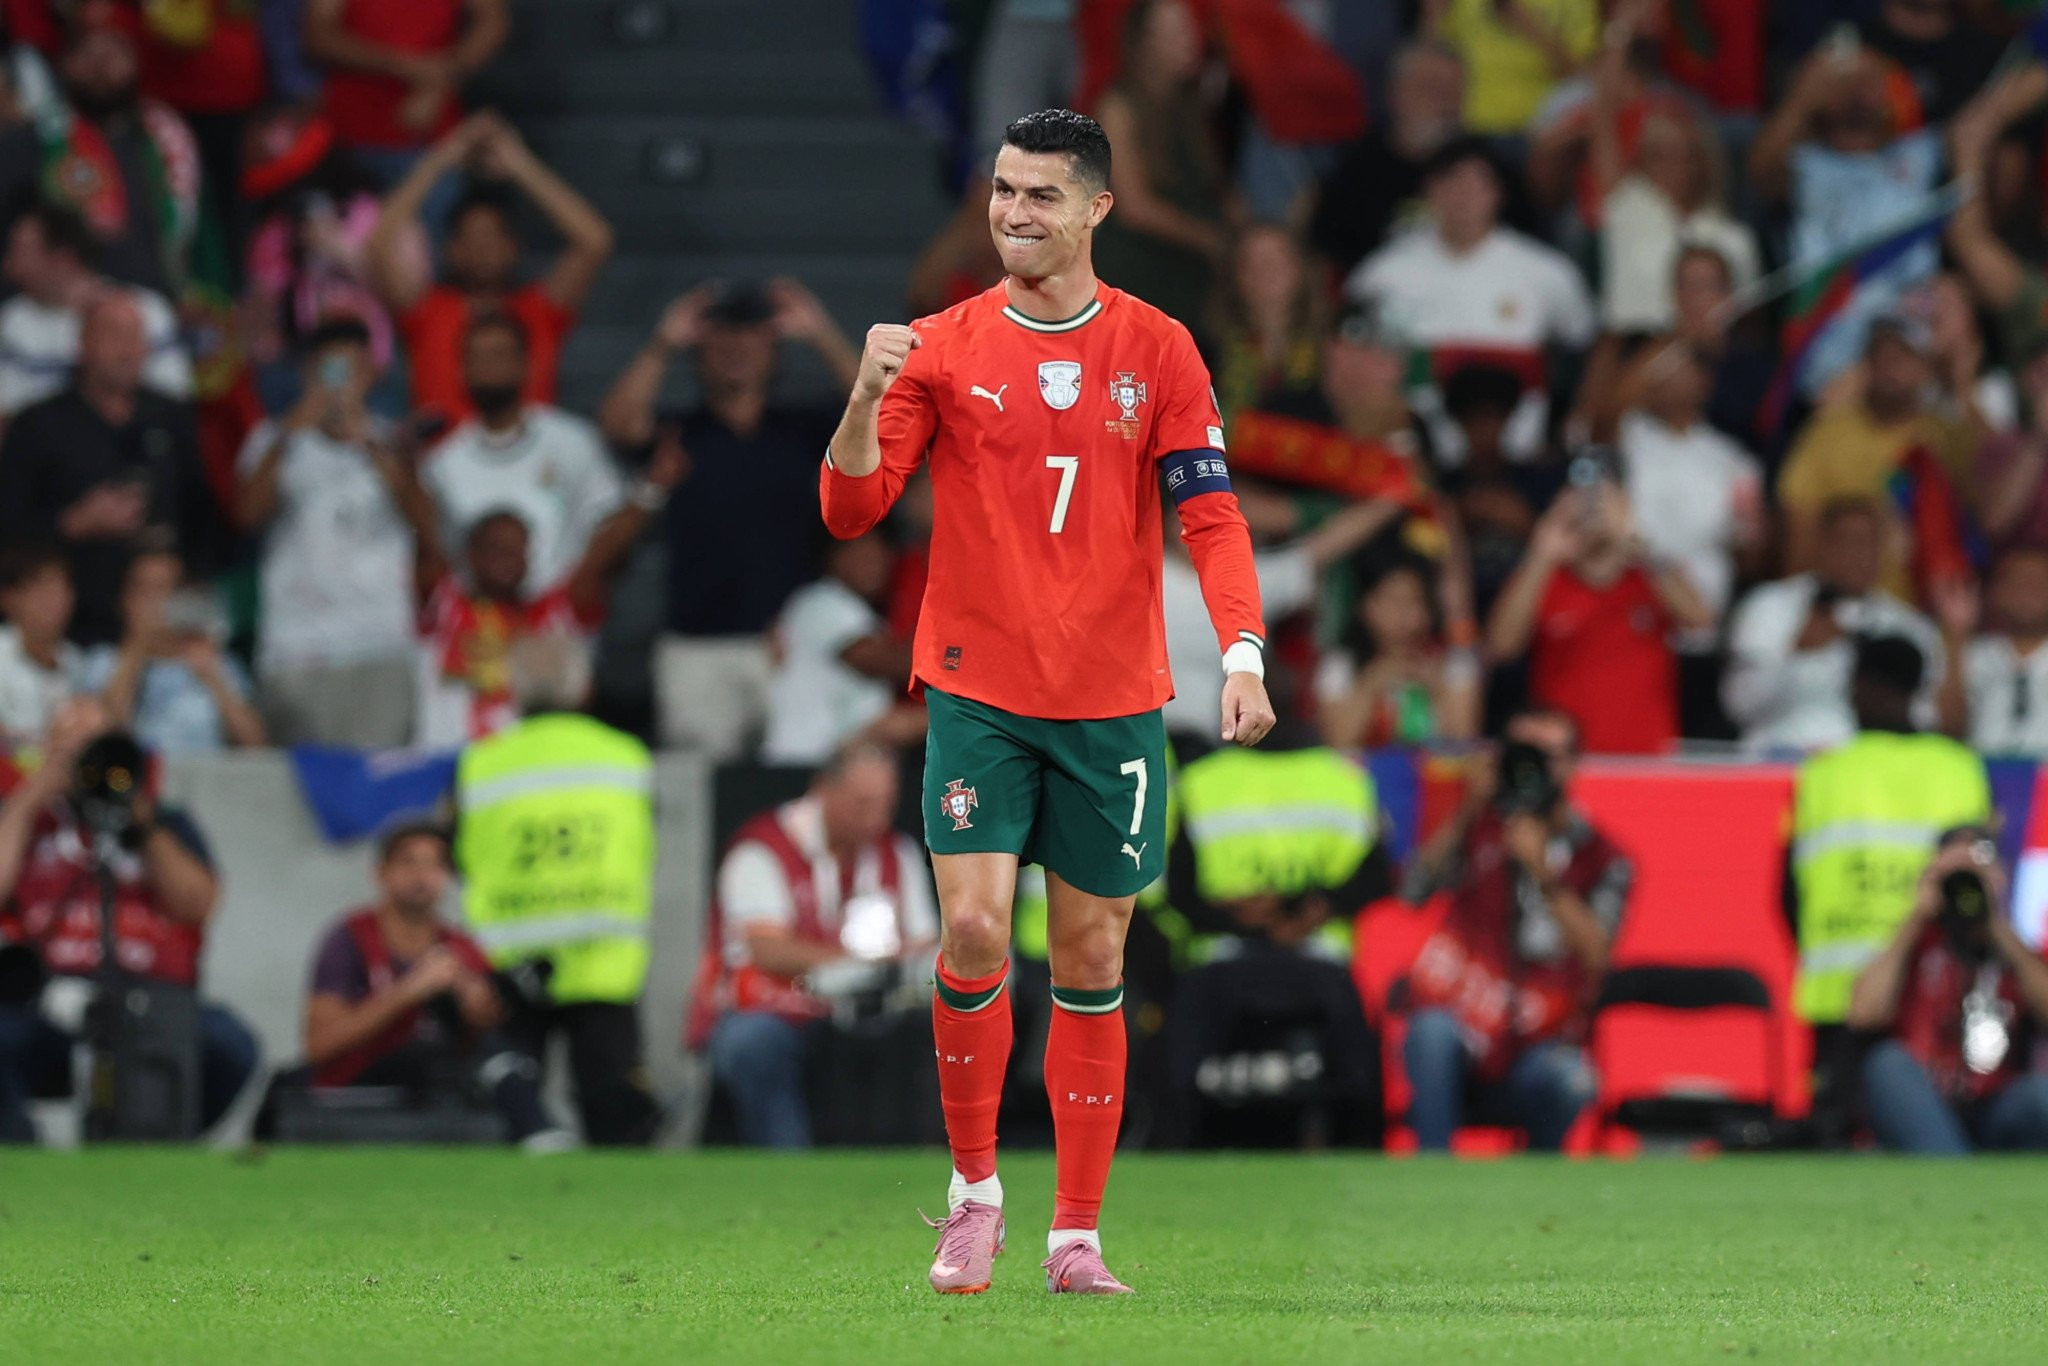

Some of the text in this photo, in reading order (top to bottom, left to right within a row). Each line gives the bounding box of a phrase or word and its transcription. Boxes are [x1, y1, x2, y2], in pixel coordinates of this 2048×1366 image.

[1045, 455, 1079, 533] 7
[1211, 462, 1228, 474] RES
[1120, 757, 1148, 835] 7
